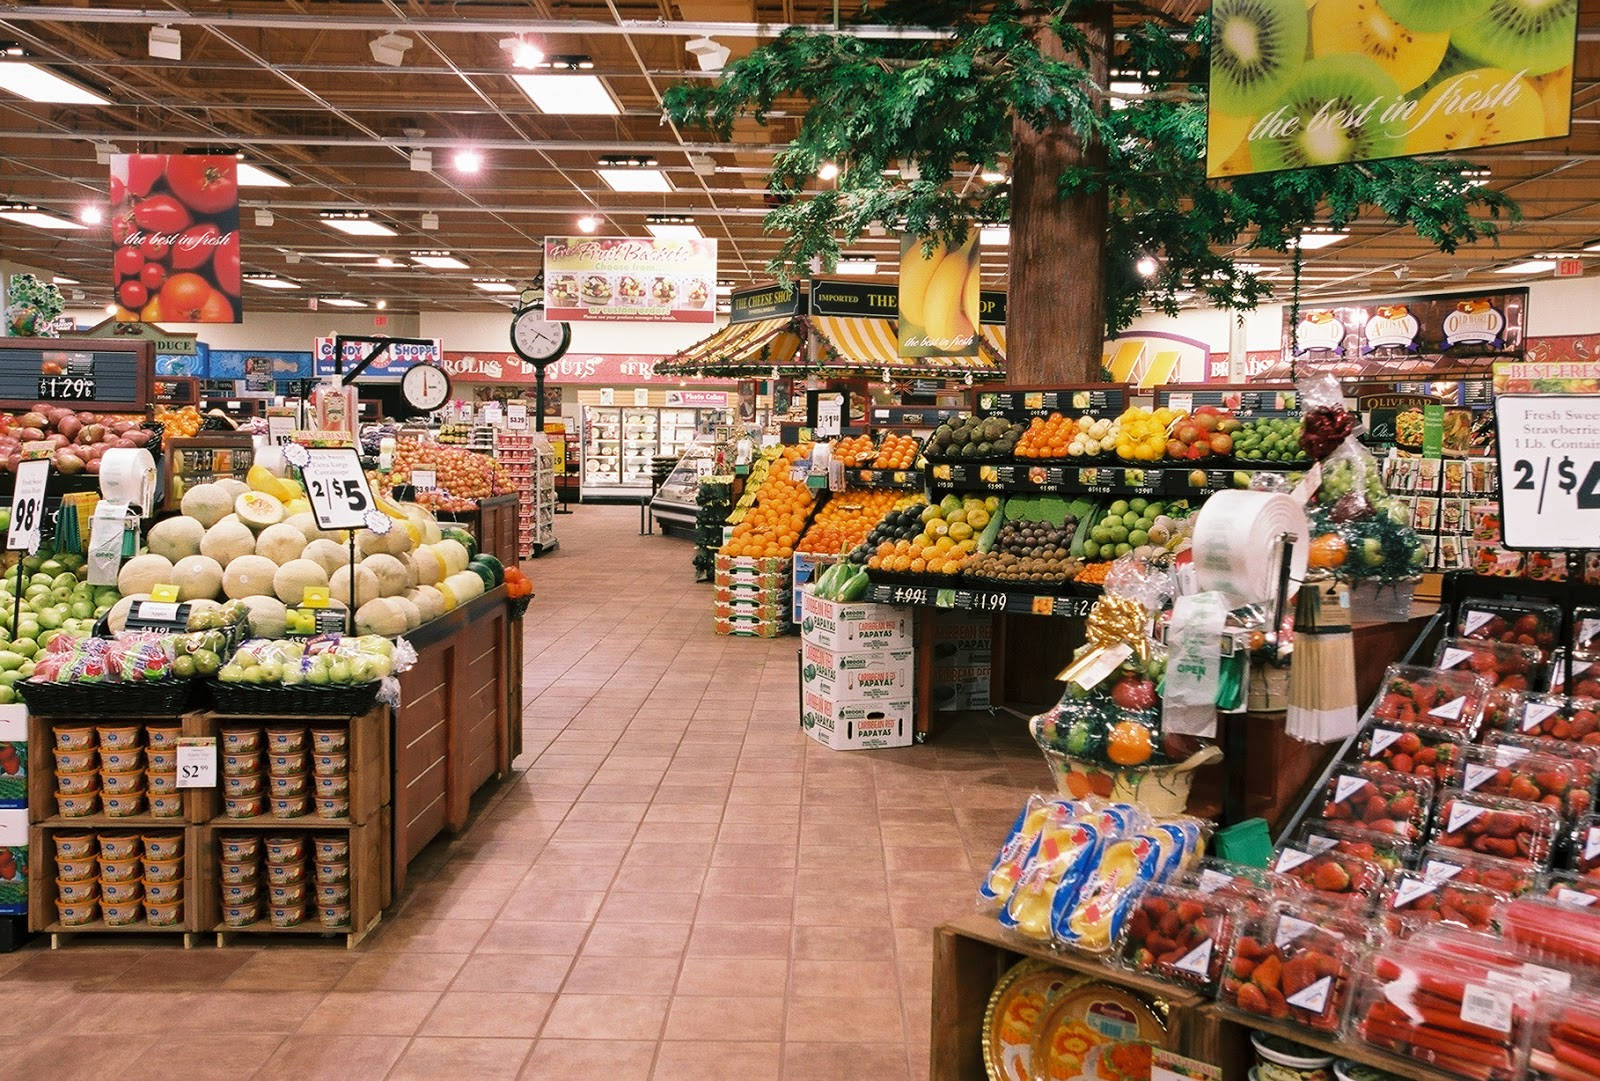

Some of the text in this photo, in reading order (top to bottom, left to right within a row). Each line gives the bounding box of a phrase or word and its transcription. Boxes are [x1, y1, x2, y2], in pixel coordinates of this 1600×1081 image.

[1248, 68, 1530, 142] the best in fresh
[123, 231, 232, 251] the best in fresh
[735, 299, 748, 311] THE
[748, 293, 774, 309] CHEESE
[818, 293, 859, 304] IMPORTED
[867, 293, 898, 308] THE
[157, 340, 191, 351] DUCE
[395, 343, 438, 356] SHOPPE
[904, 335, 920, 347] the
[920, 335, 938, 347] best
[944, 334, 975, 351] fresh
[521, 360, 596, 376] DNUTS
[1524, 409, 1561, 421] Fresh
[1514, 438, 1520, 449] 1
[1524, 438, 1546, 449] Lb.
[813, 616, 836, 631] PAPAYAS
[859, 630, 892, 638] PAPAYAS
[816, 664, 836, 680] PAPAYAS
[859, 679, 893, 688] PAPAYAS
[815, 712, 835, 730] PAPAYAS
[858, 728, 892, 738] PAPAYAS
[182, 765, 199, 779] $2
